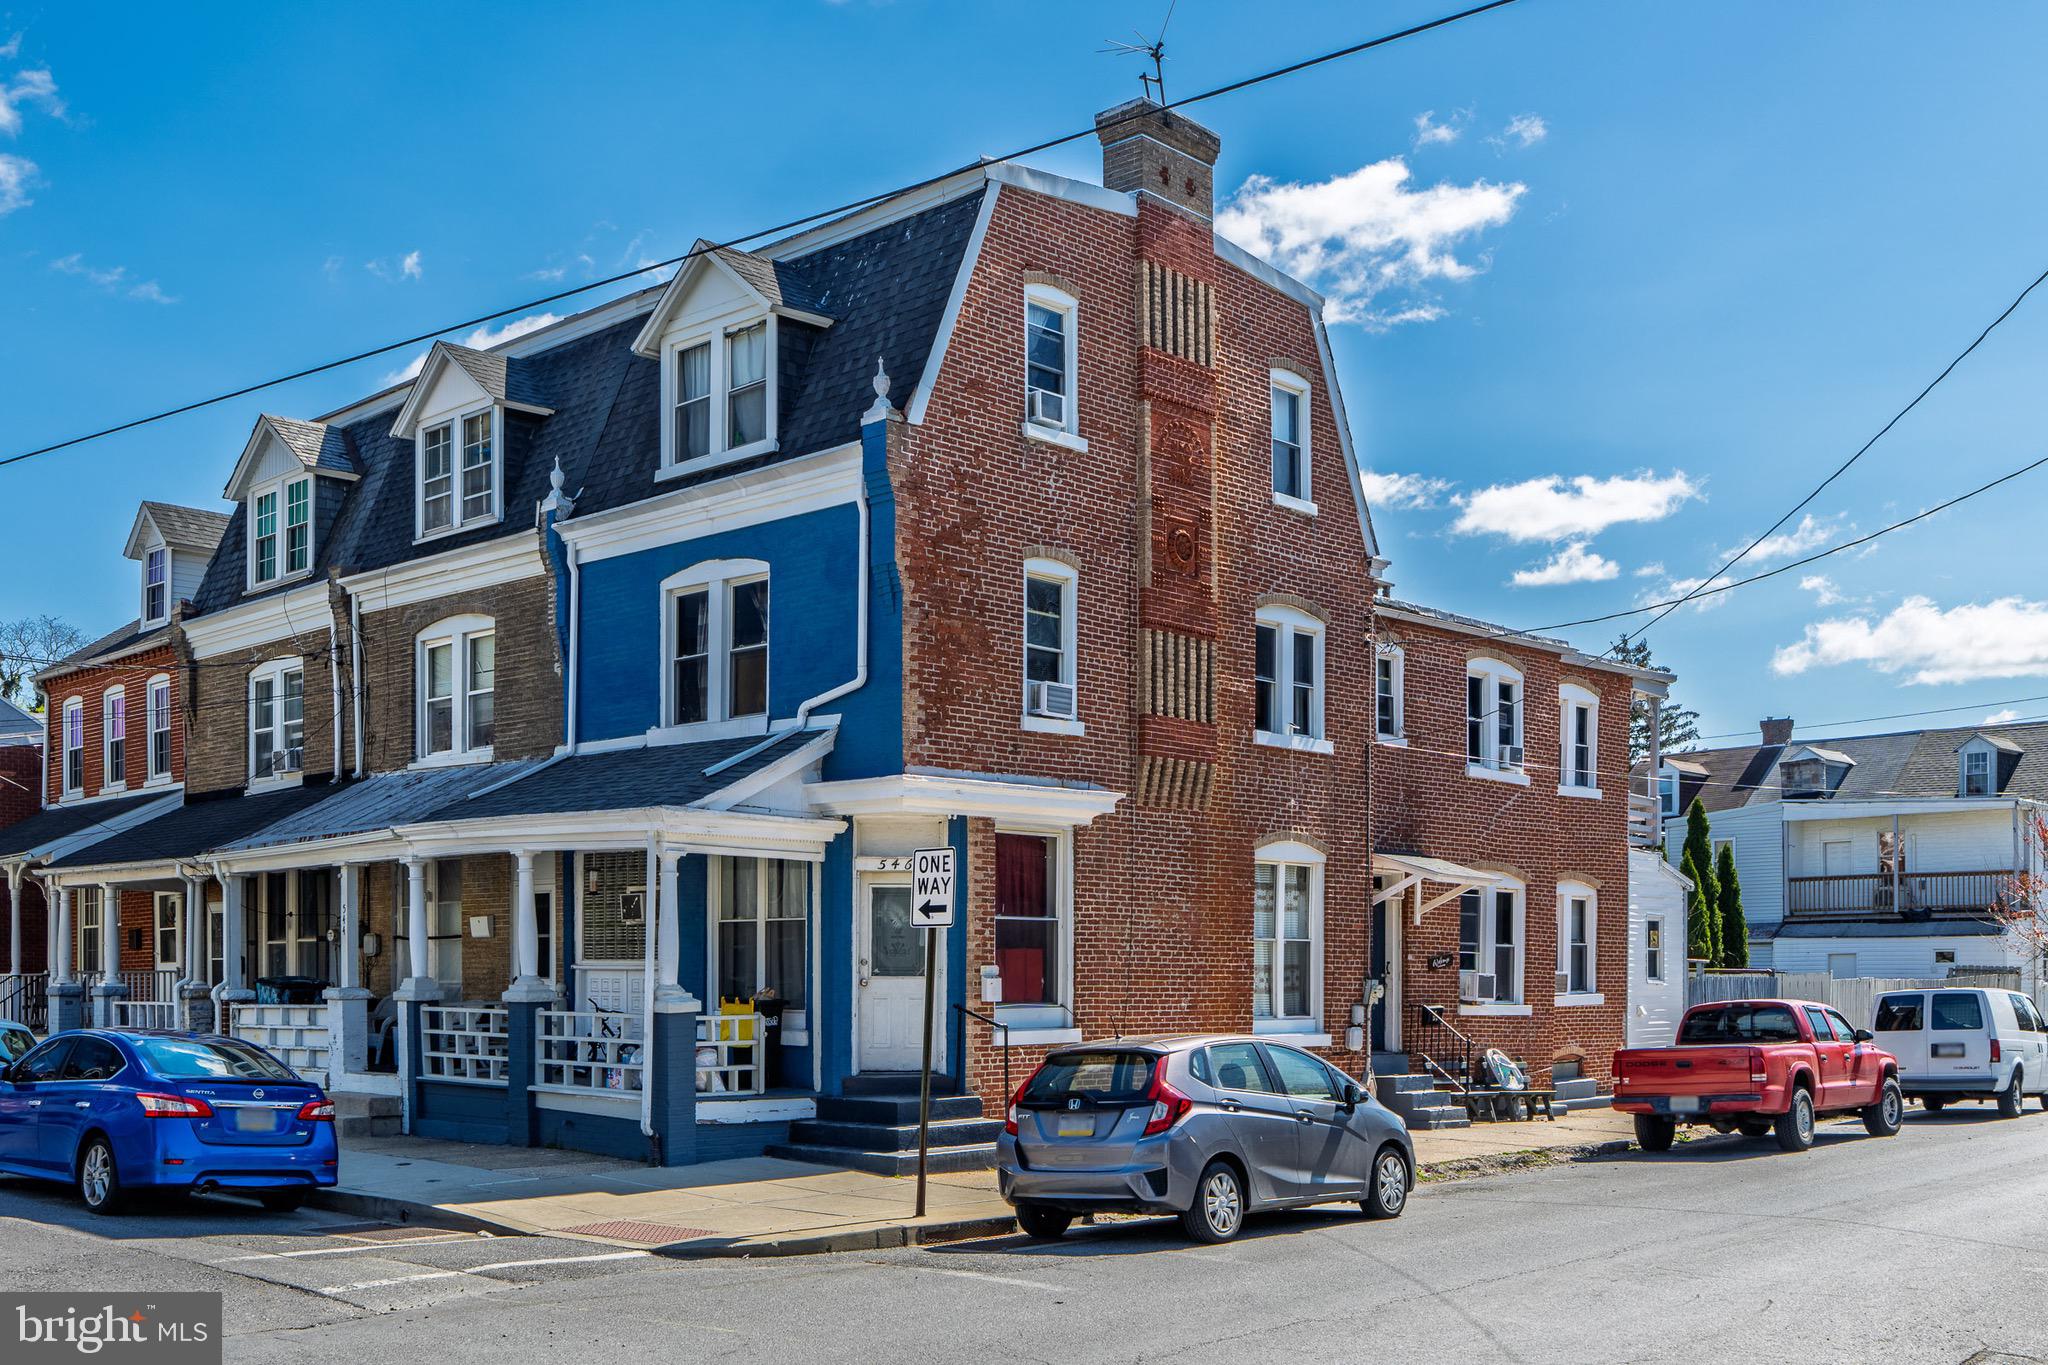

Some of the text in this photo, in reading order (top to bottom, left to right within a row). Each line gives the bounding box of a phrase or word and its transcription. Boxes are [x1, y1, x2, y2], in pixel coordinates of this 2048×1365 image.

[877, 858, 913, 870] 546
[919, 854, 951, 873] ONE
[918, 876, 952, 896] WAY
[185, 1088, 216, 1097] SENTRA
